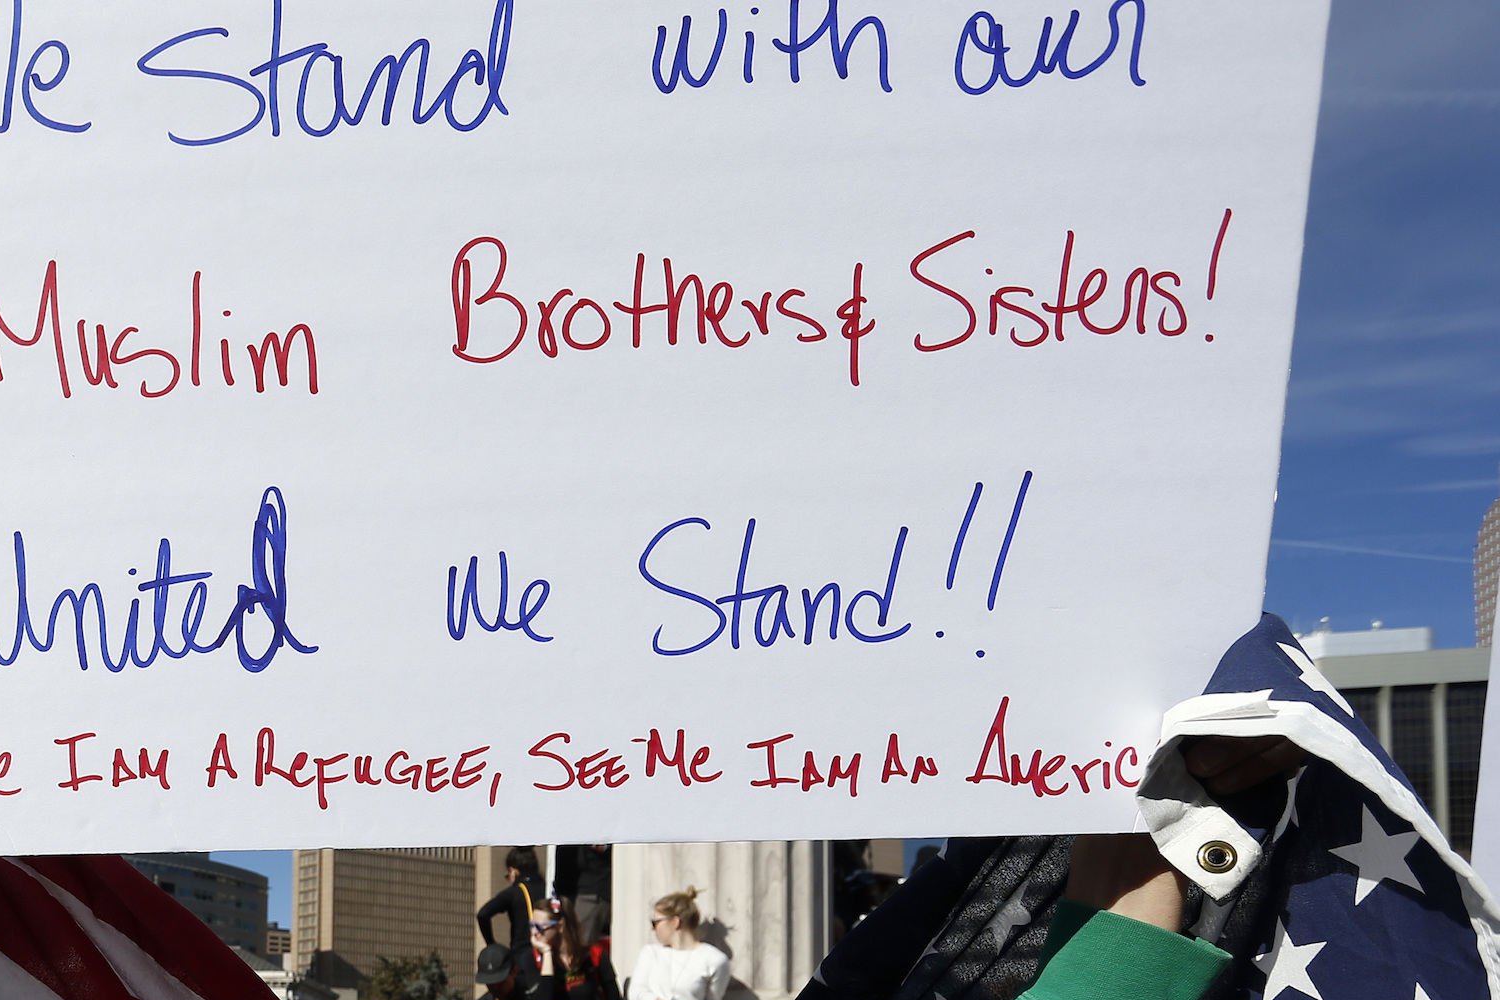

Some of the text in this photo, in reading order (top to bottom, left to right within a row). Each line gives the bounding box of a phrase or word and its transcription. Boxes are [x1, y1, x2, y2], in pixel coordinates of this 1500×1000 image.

[138, 0, 514, 146] Stand
[653, 0, 893, 94] with
[955, 0, 1146, 96] our
[452, 236, 827, 364] Brothers
[911, 208, 1234, 352] Sisters!
[447, 551, 554, 643] We
[638, 470, 1034, 658] Stand!!
[54, 732, 104, 791] I
[112, 747, 171, 790] AM
[205, 733, 238, 788] A
[645, 728, 723, 787] Me
[747, 733, 800, 789] I
